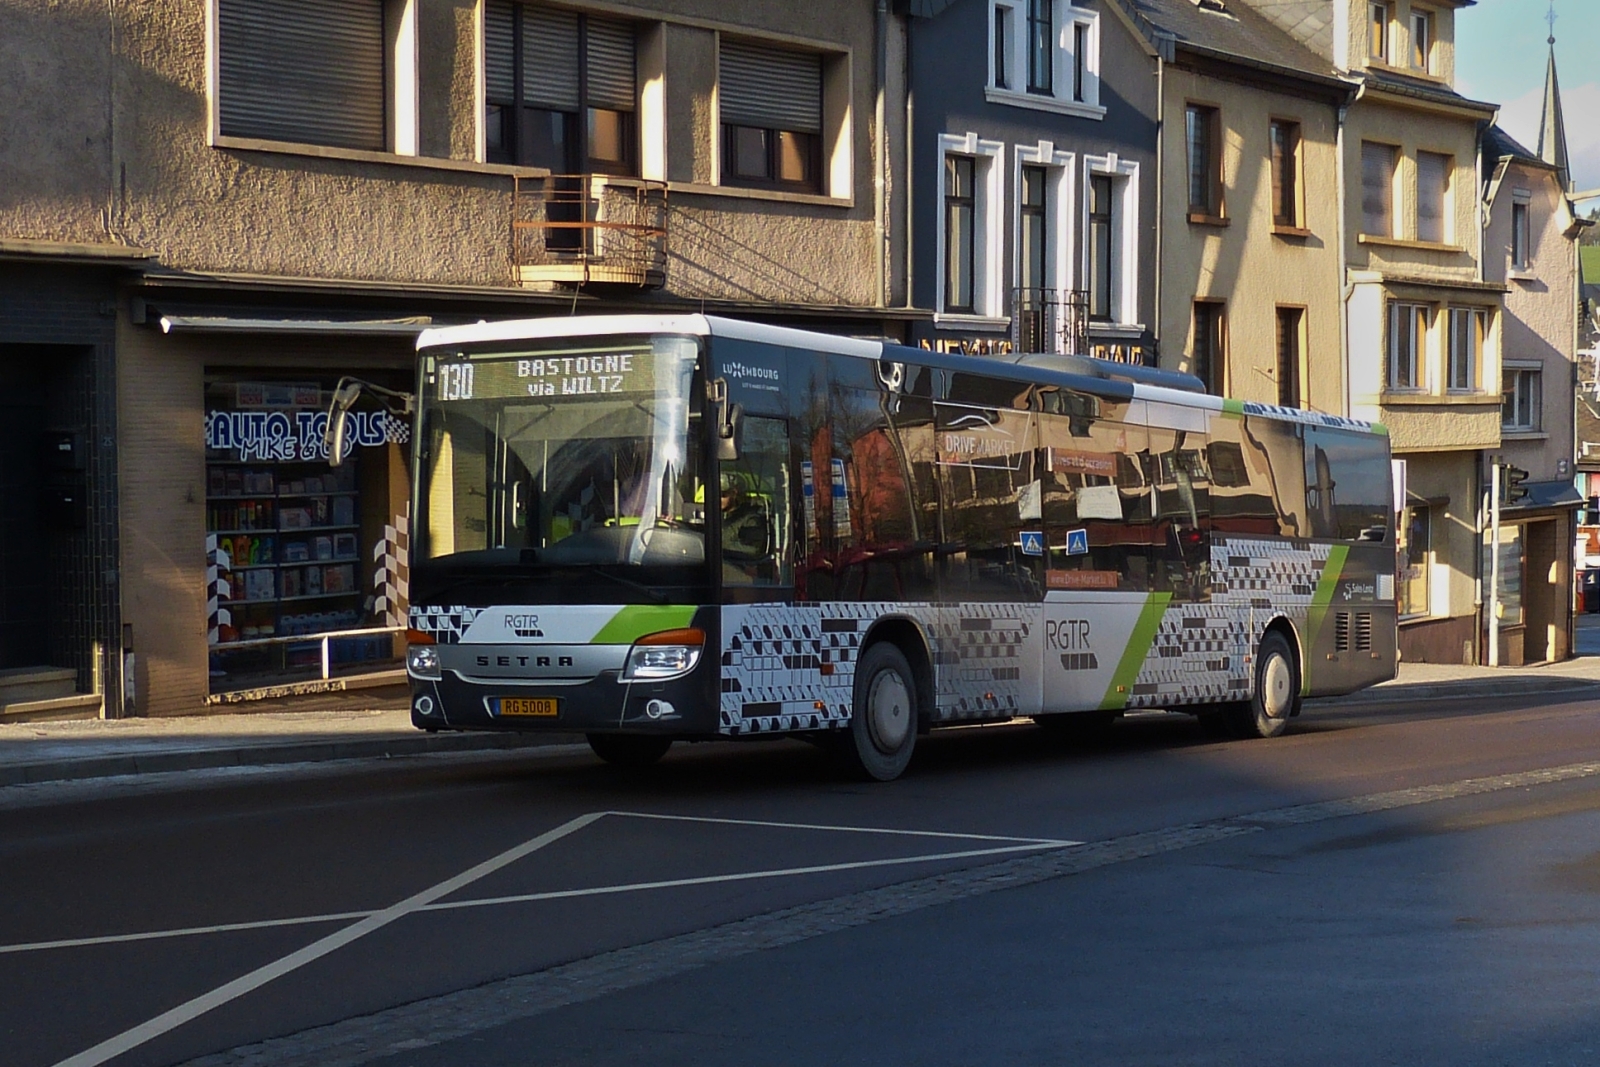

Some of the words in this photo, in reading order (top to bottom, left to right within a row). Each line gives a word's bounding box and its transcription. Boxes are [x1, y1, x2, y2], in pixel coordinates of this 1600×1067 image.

[518, 354, 633, 377] BASTOGNE
[723, 362, 778, 380] LUXEMBOURG
[439, 363, 474, 400] 130
[527, 379, 555, 396] via
[562, 375, 624, 395] WILTZ
[211, 411, 291, 448] AUTO
[240, 436, 298, 461] MIKE
[945, 435, 975, 454] DRIVE
[976, 438, 1016, 457] MARKET
[505, 615, 539, 628] RGTR
[1046, 620, 1090, 650] RGTR
[477, 656, 573, 667] SETRA
[505, 701, 520, 713] RG
[522, 701, 551, 713] 5008
